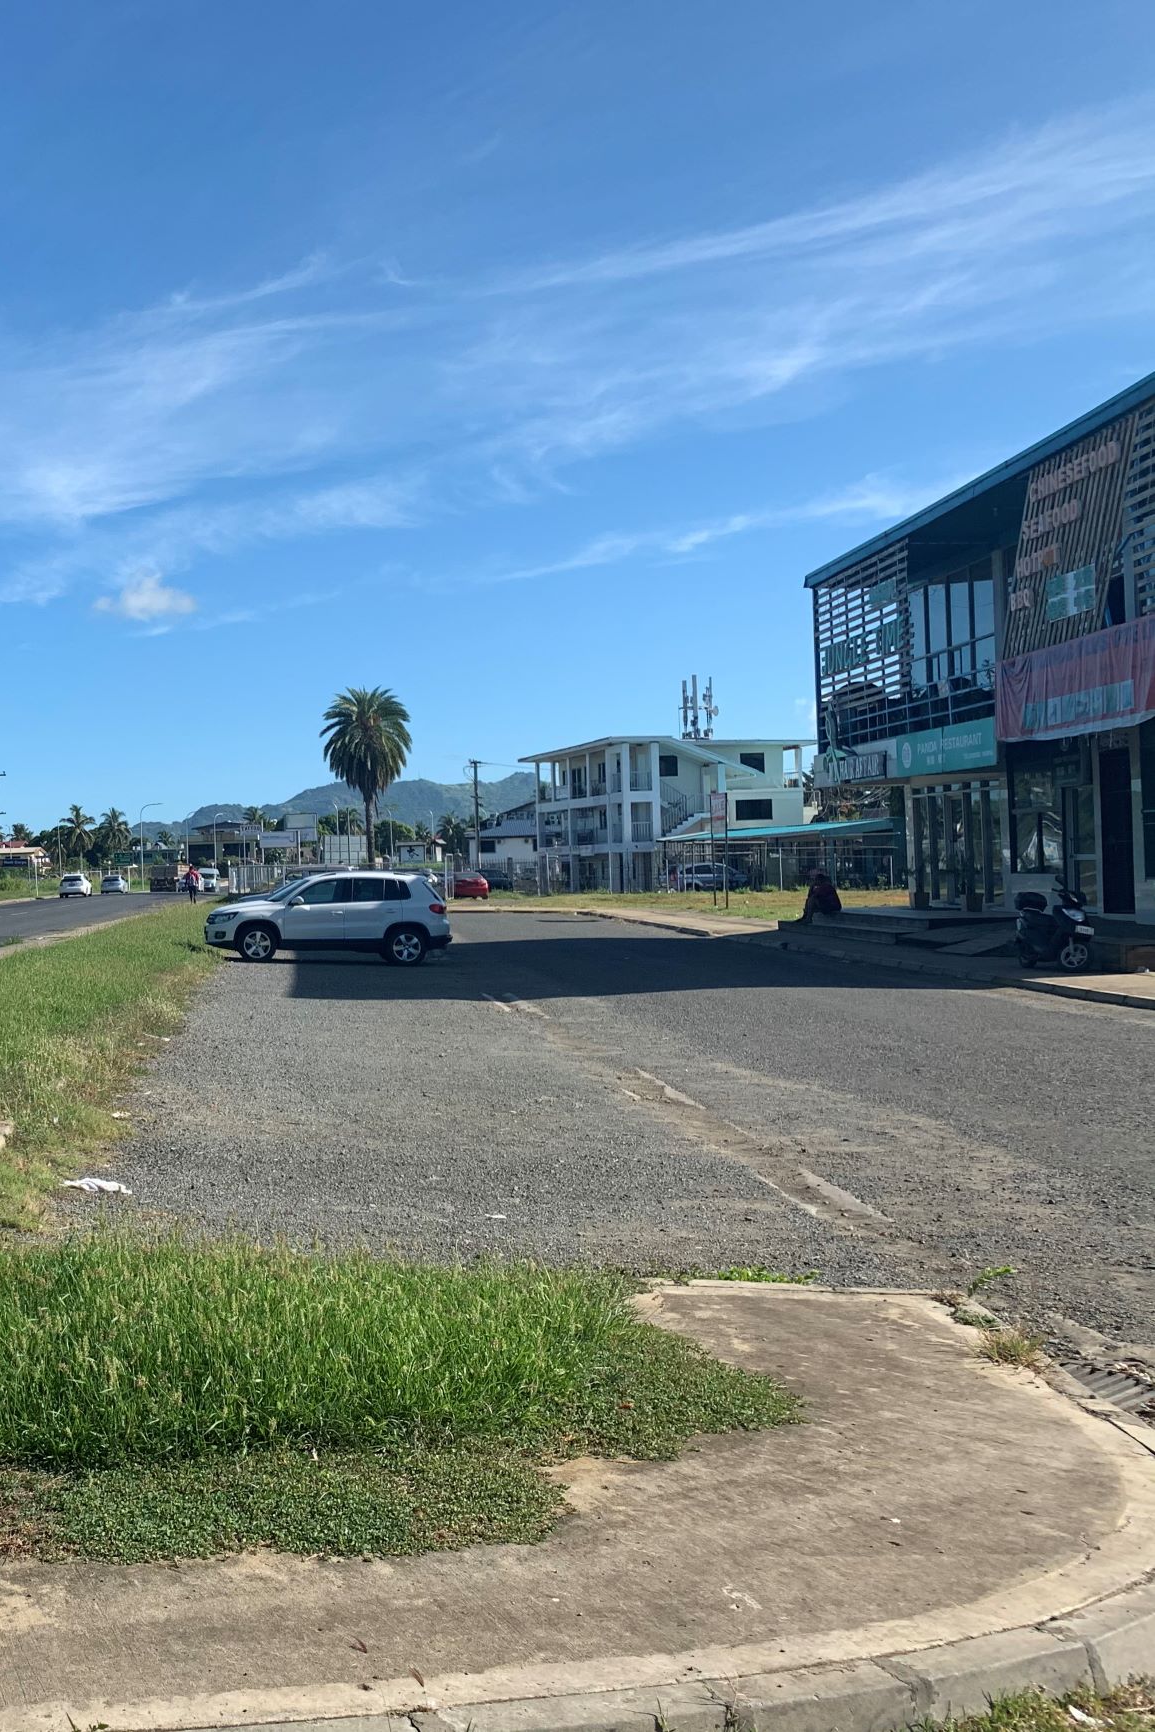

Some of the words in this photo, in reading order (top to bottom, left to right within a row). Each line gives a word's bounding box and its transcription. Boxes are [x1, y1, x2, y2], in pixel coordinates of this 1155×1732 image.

[1022, 499, 1079, 540] SEAFOOD
[1010, 588, 1032, 612] BBQ
[821, 632, 869, 675] JUNGLE
[873, 615, 903, 655] TIME
[917, 741, 937, 755] PANDA
[940, 732, 982, 751] RESTAURANT
